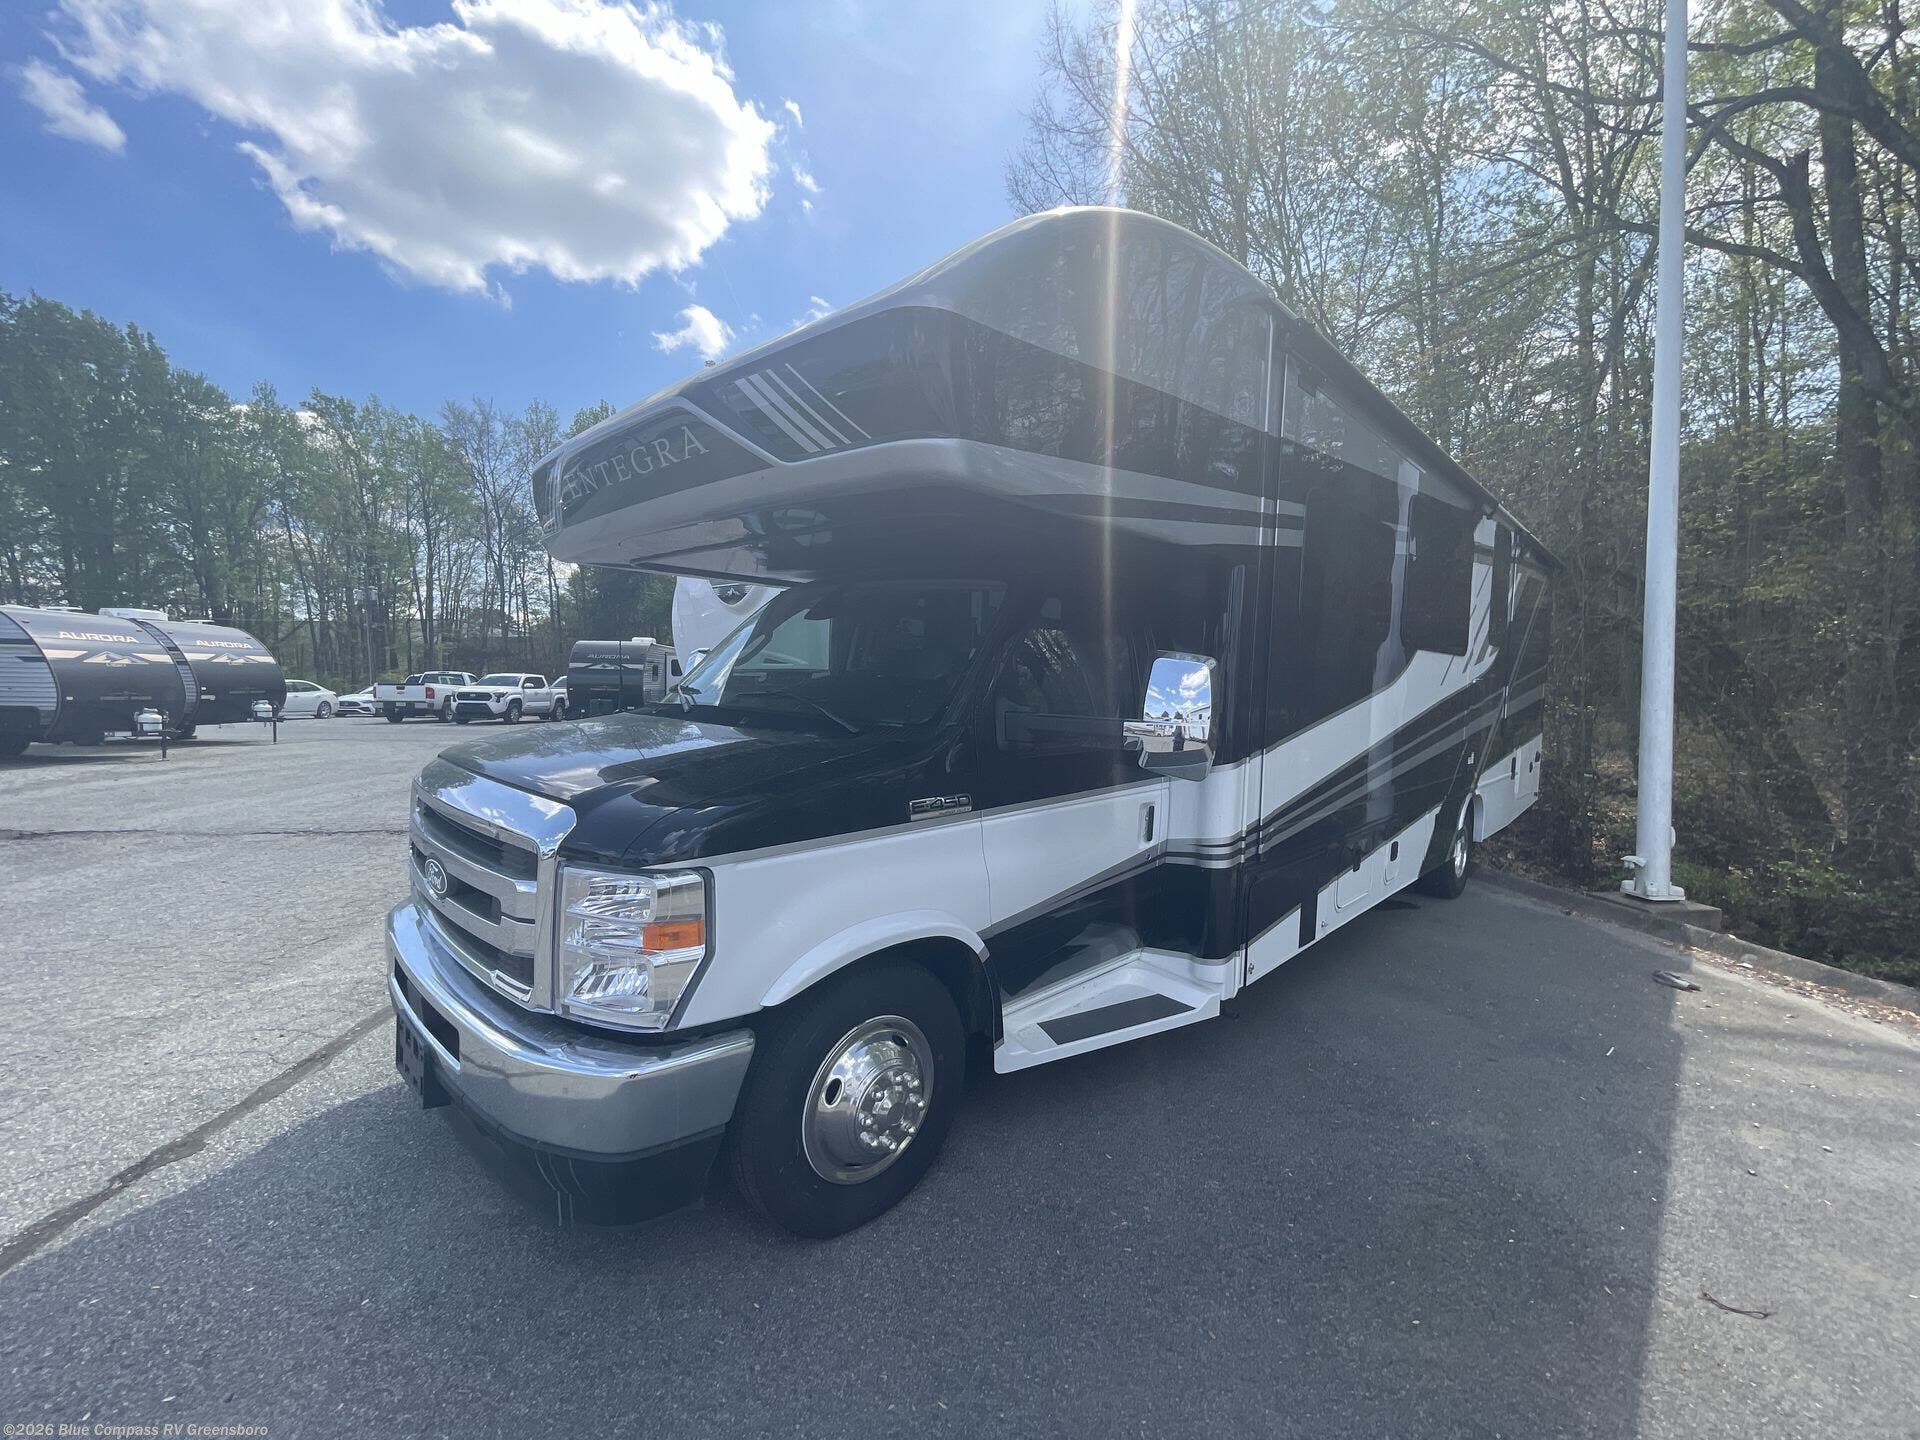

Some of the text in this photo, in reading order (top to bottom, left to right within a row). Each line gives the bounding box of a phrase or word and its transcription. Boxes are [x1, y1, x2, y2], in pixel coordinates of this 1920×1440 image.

[564, 426, 709, 499] ENTEGRA
[58, 631, 139, 643] AURORA
[196, 639, 253, 649] AURORA
